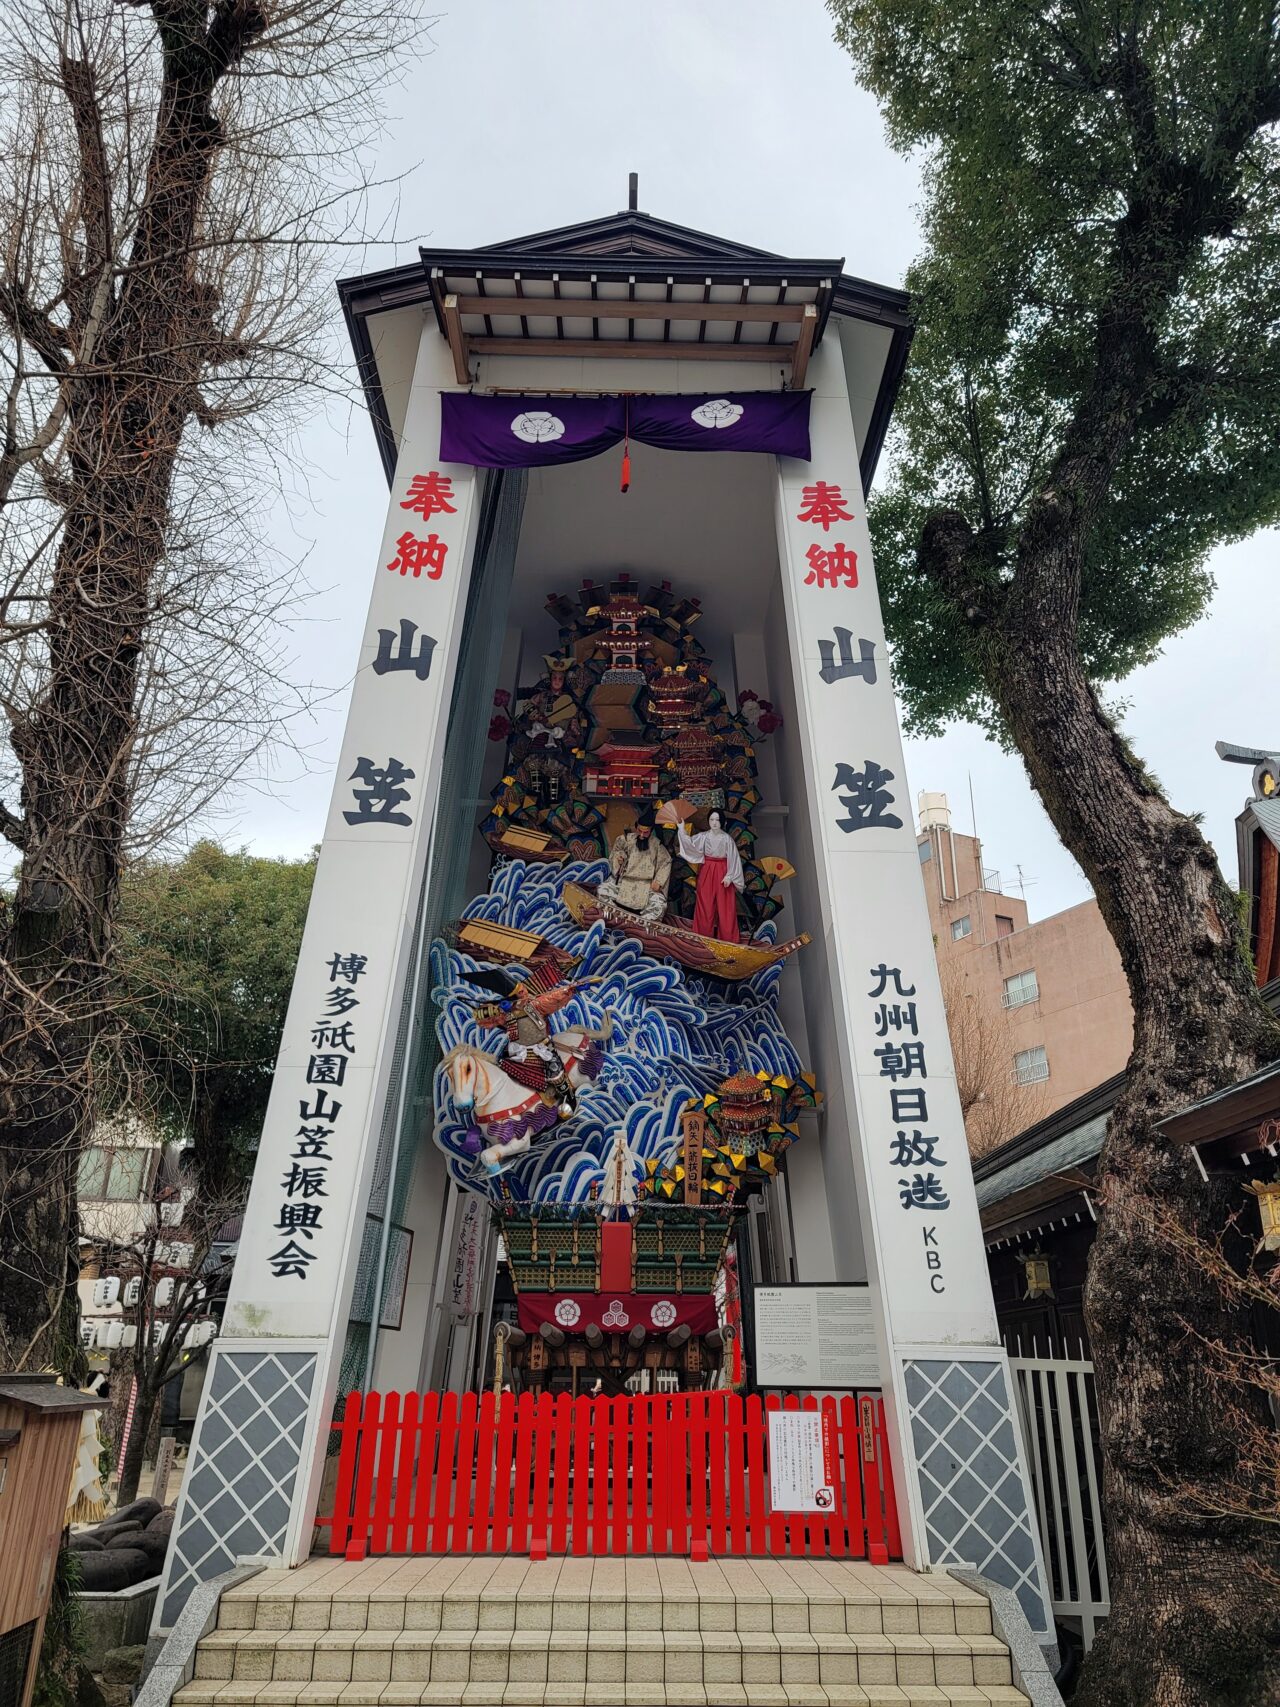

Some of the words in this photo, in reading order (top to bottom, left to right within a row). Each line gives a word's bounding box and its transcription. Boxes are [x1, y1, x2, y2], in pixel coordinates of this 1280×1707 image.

[388, 471, 457, 581] 奉納
[797, 481, 858, 589] 奉納
[343, 618, 438, 827] 山笠
[818, 626, 904, 834] 山笠
[267, 952, 367, 1280] 博多祇園山笠振興会
[867, 963, 950, 1211] 九州朝日放送
[923, 1226, 945, 1294] KBC
